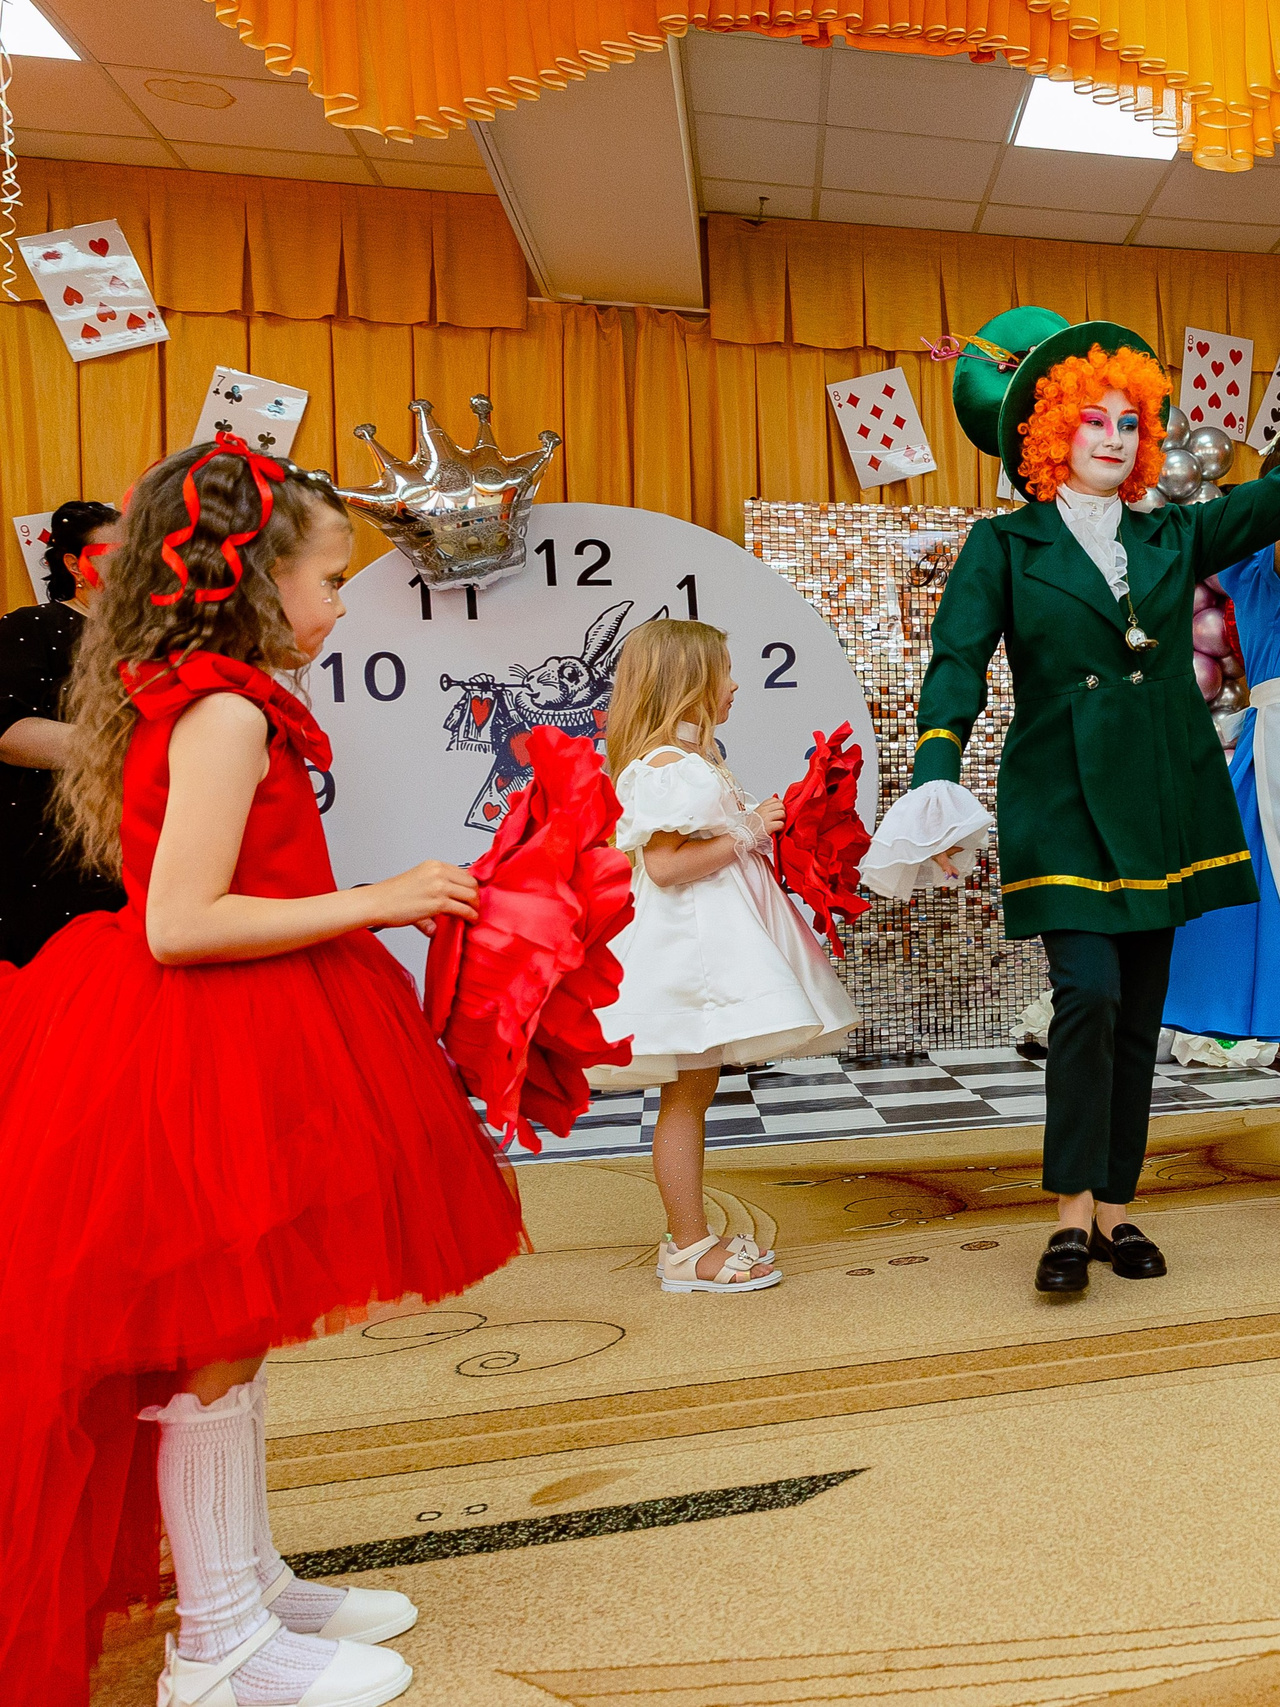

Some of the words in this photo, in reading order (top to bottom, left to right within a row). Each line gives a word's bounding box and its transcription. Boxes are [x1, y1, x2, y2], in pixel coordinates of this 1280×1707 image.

[1188, 334, 1194, 344] 8
[217, 374, 226, 387] 7
[833, 391, 841, 401] 8
[1238, 424, 1244, 434] 8
[20, 525, 31, 537] 9
[534, 538, 612, 586] 12
[408, 573, 478, 621] 11
[676, 574, 699, 620] 1
[319, 651, 407, 703] 10
[761, 641, 798, 689] 2
